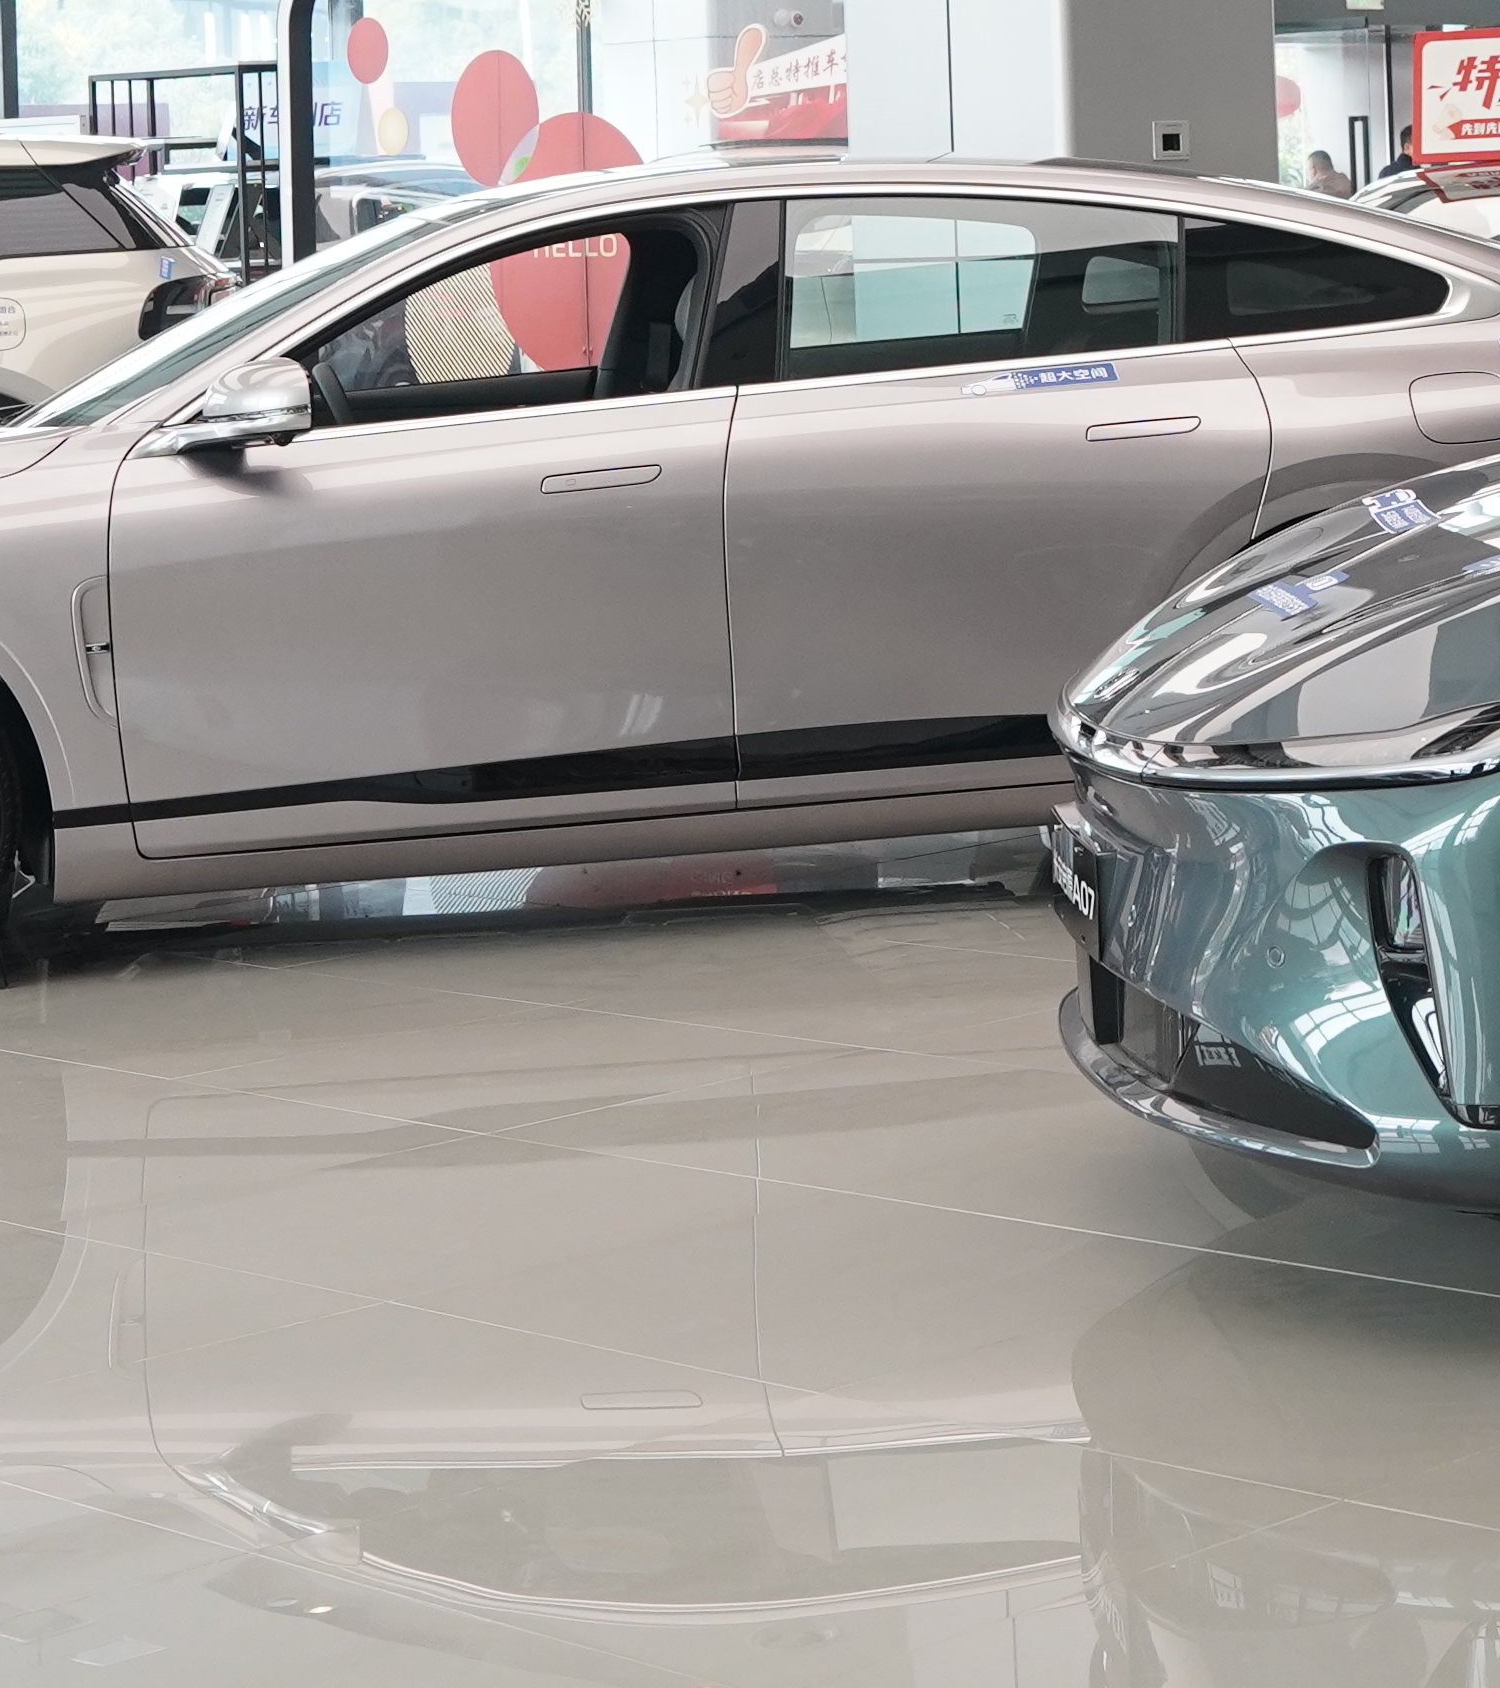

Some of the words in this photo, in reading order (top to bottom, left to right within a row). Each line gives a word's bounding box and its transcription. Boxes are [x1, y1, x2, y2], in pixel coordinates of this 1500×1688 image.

[751, 49, 847, 91] 店总特推车
[533, 233, 618, 258] HELLO
[1039, 367, 1108, 383] 超大空间
